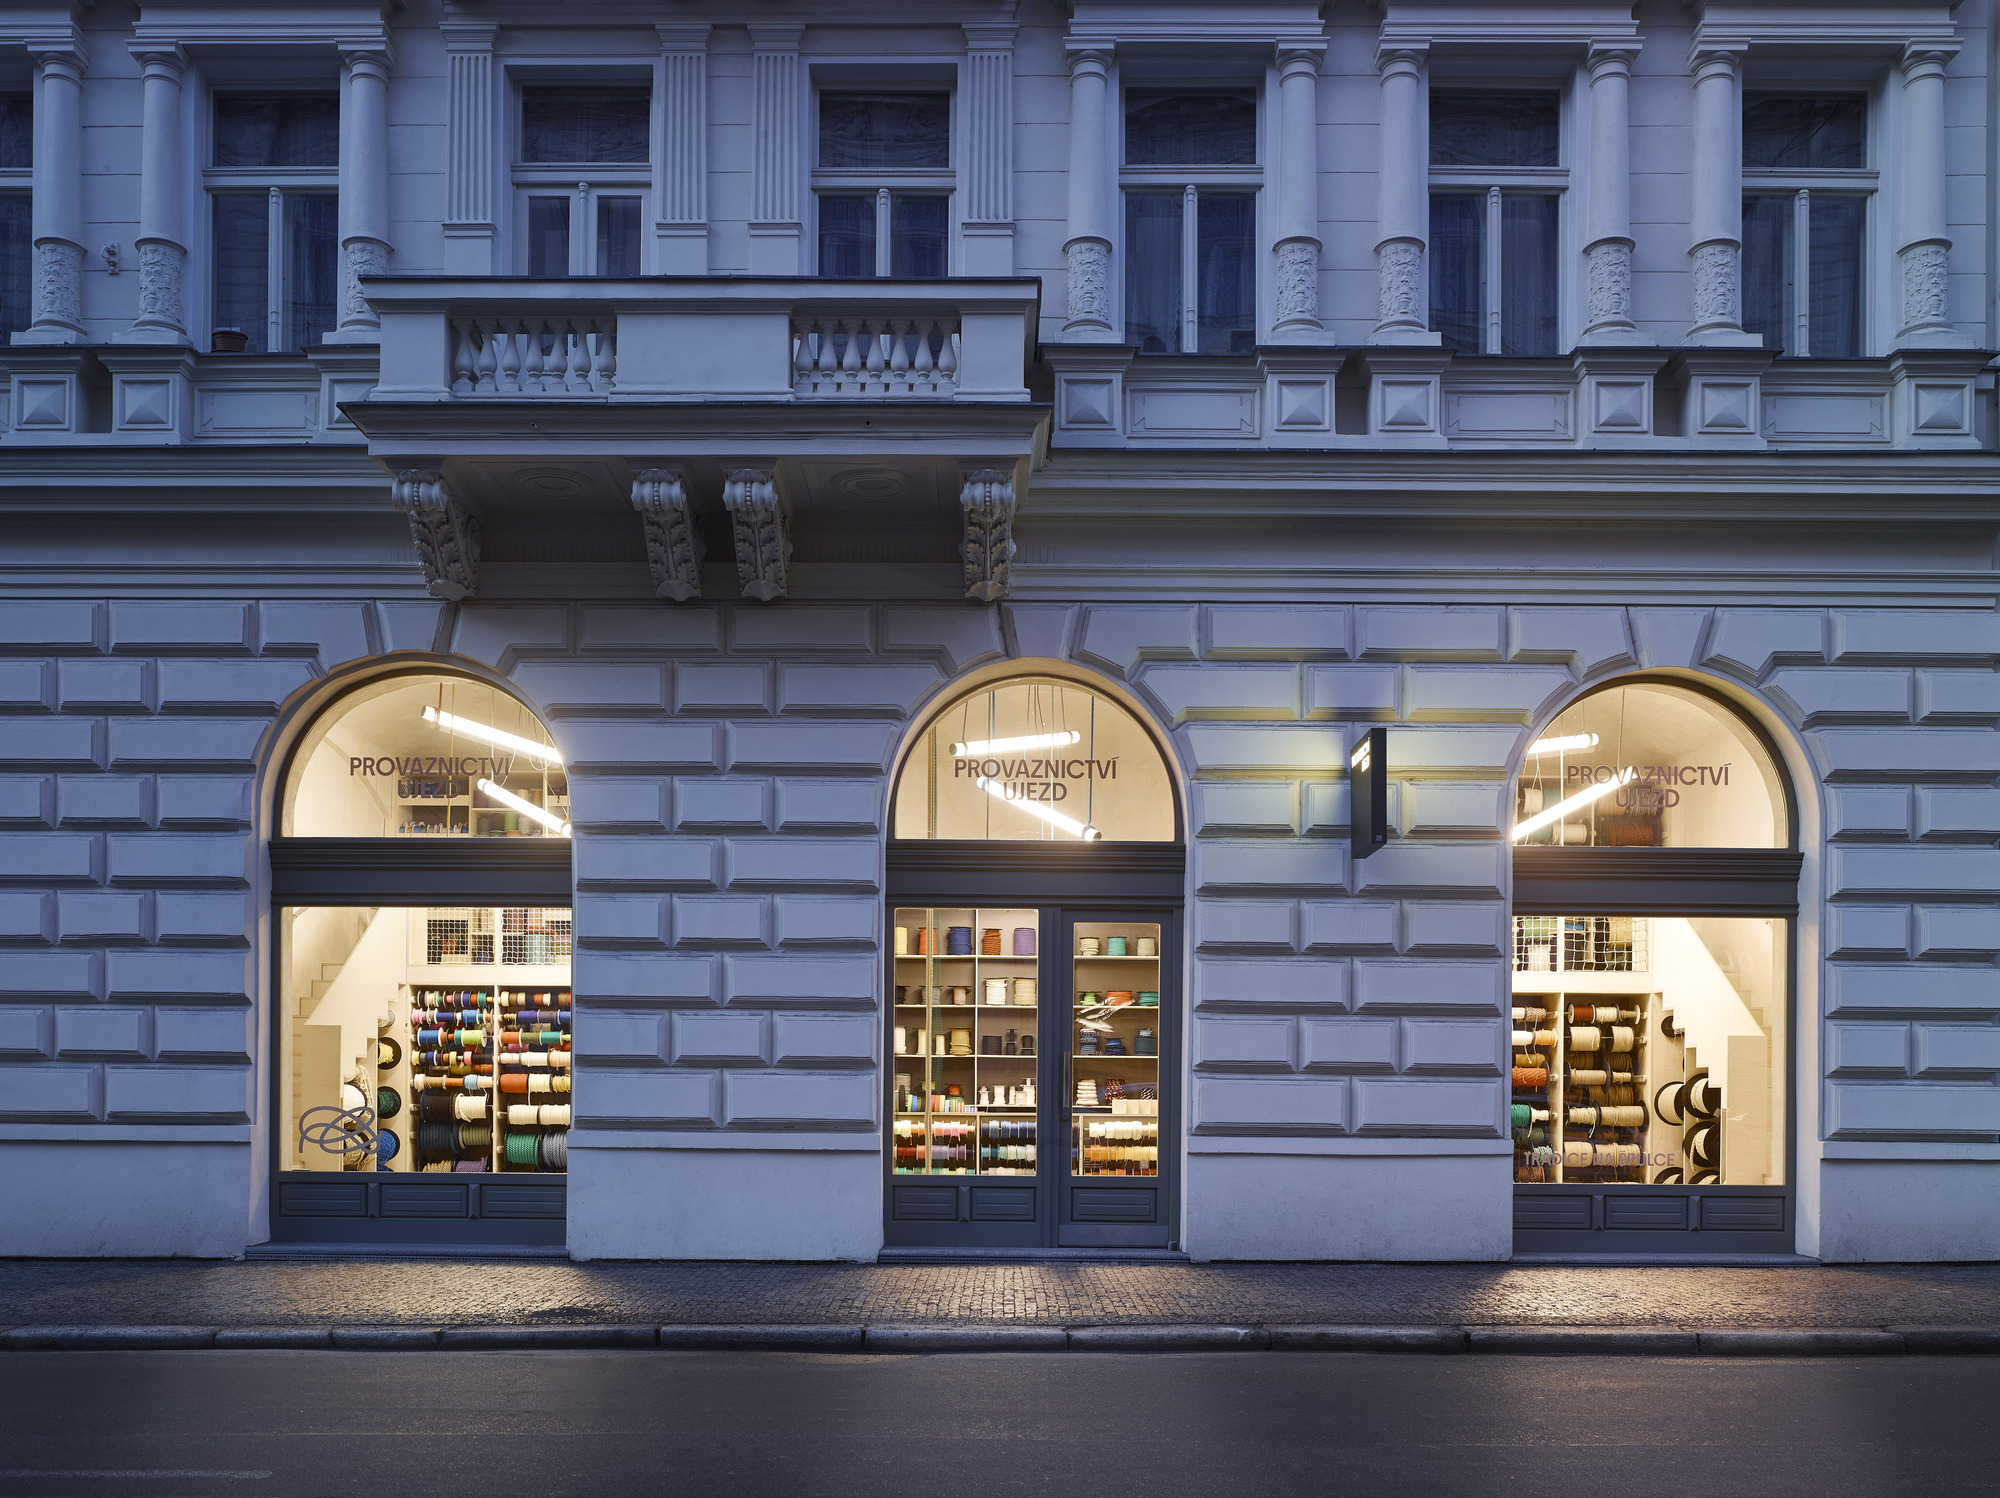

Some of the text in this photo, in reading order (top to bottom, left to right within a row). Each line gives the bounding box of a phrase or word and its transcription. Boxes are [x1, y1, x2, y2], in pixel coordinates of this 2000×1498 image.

[350, 754, 512, 777] PROVAZNICTVÍ
[954, 756, 1119, 779] PROVAZNICTVÍ
[1567, 762, 1732, 786] PROVAZNICTVÍ
[398, 776, 461, 799] ÚJEZD
[1003, 778, 1068, 801] ÚJEZD
[1524, 1151, 1675, 1166] TRADICE NA ŠPULCE
